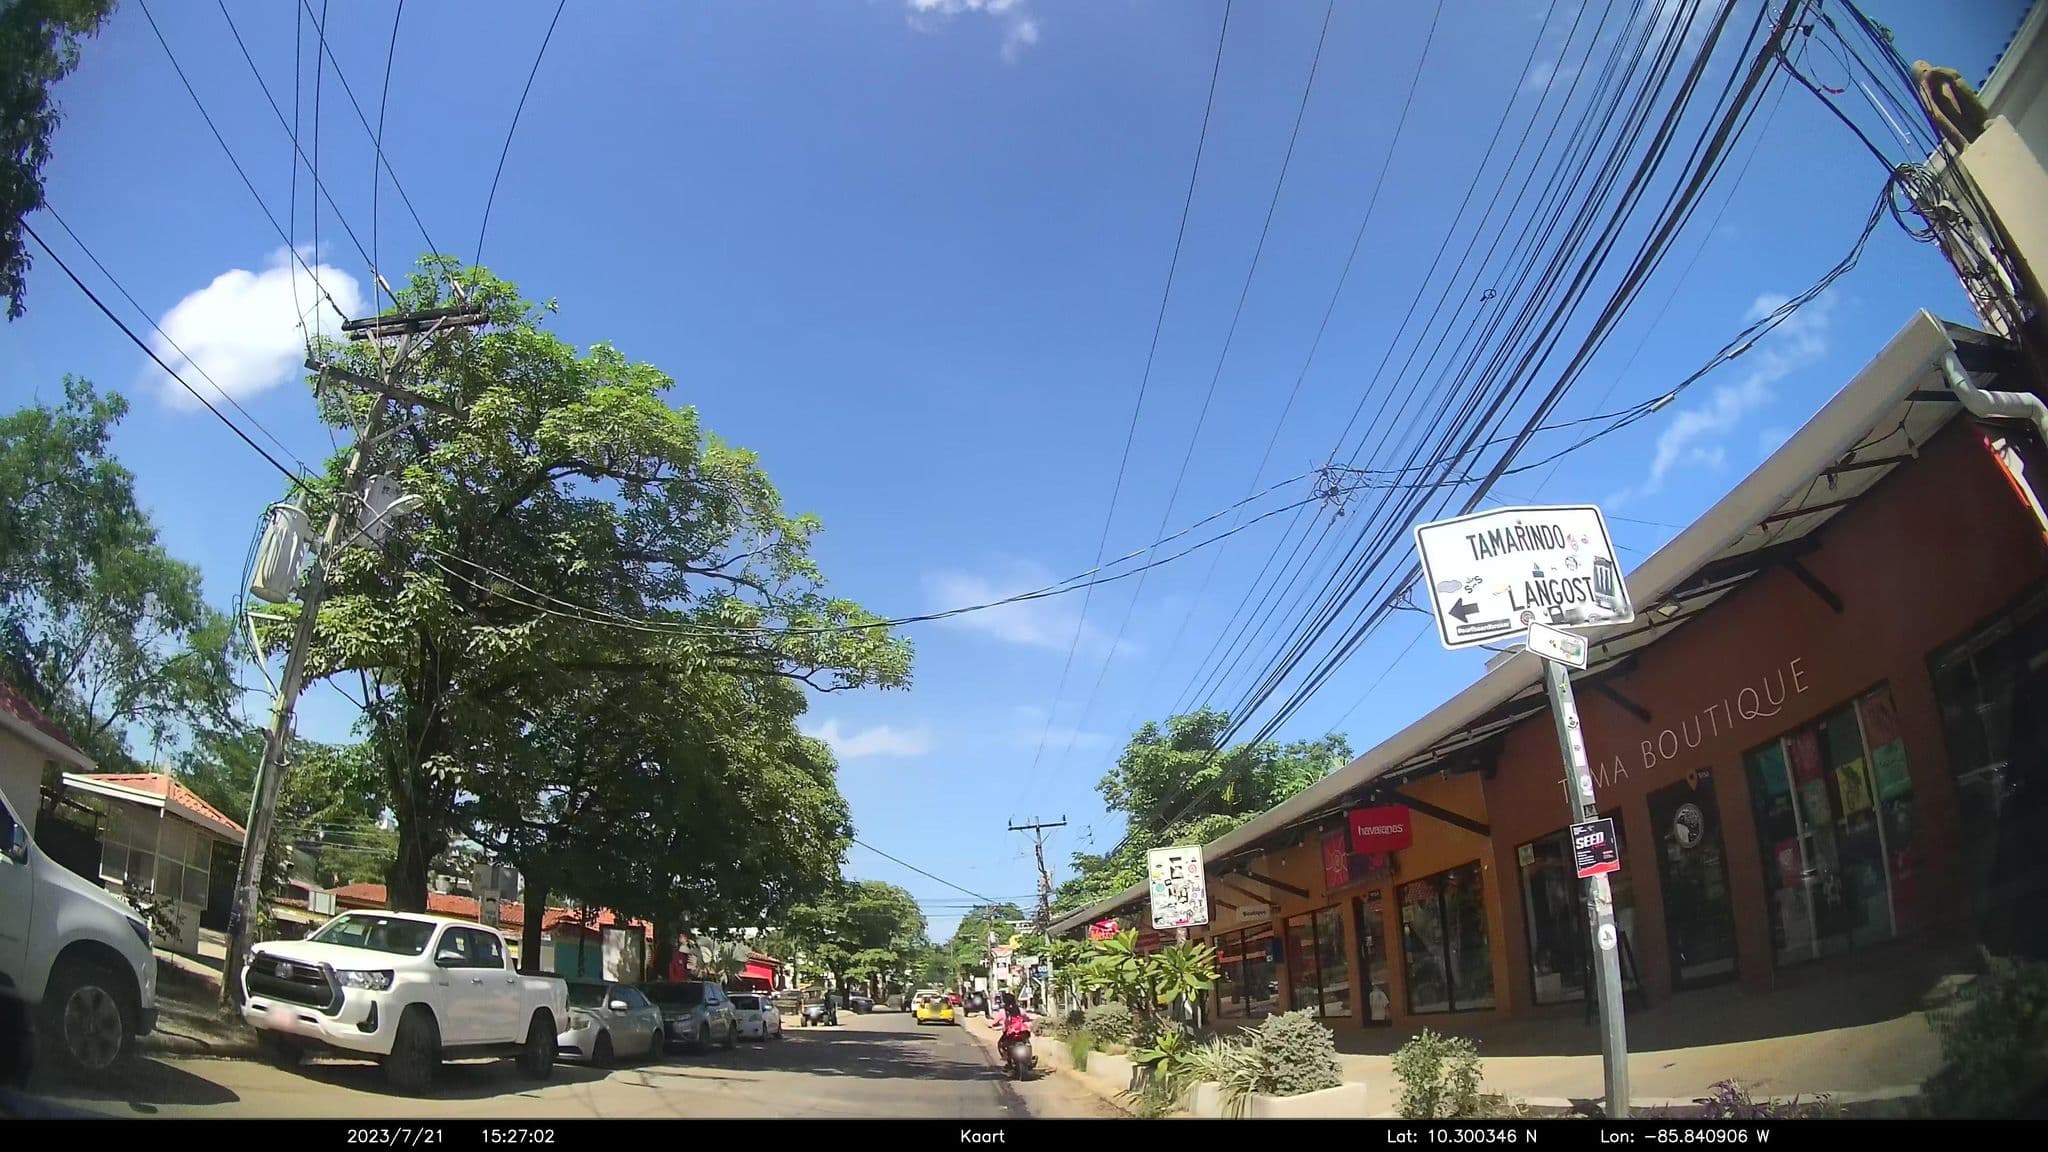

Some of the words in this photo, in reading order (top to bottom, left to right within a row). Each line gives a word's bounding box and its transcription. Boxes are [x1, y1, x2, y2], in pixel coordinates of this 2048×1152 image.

[1466, 524, 1566, 561] TAMARINDO
[1508, 577, 1597, 611] LANGOST
[1558, 755, 1629, 804] TMA
[1640, 657, 1808, 769] BOUTIQUE
[1357, 823, 1403, 836] havaianas
[1575, 831, 1604, 850] SEED
